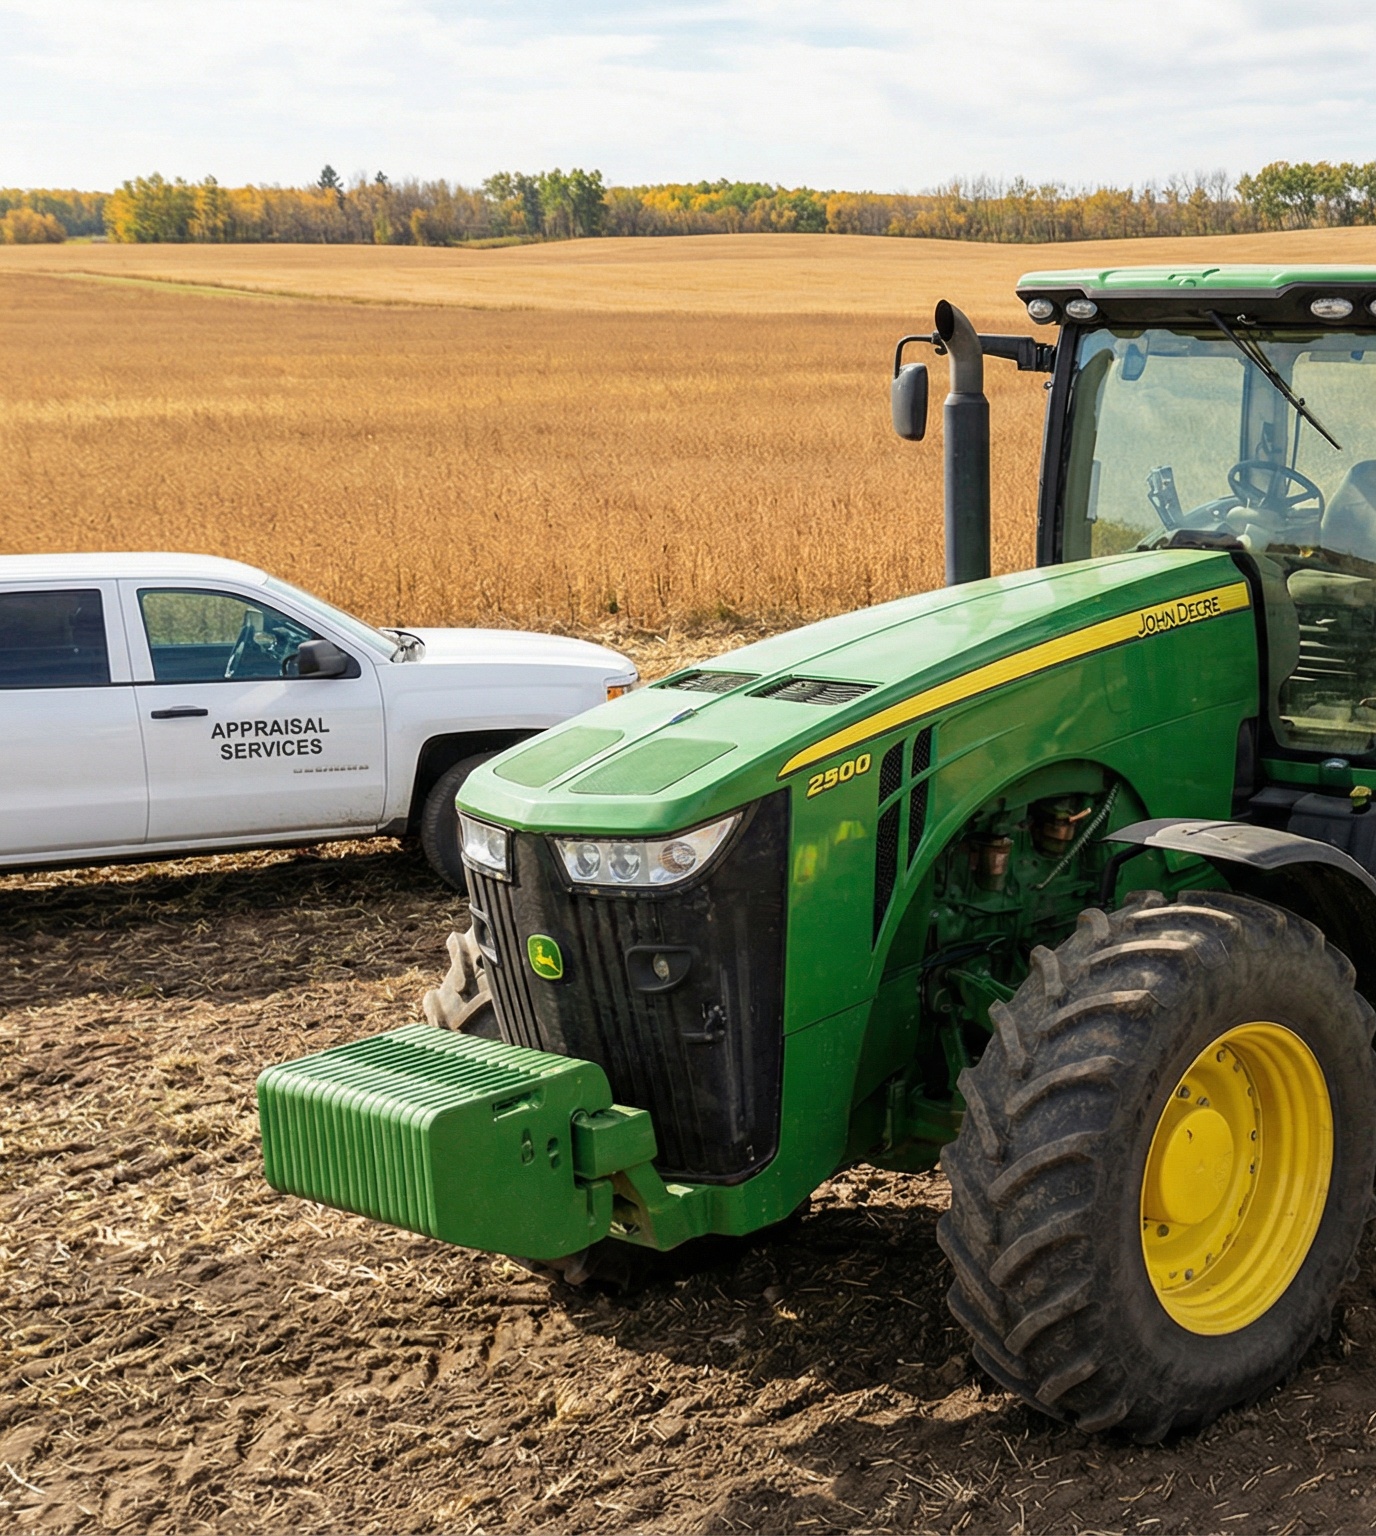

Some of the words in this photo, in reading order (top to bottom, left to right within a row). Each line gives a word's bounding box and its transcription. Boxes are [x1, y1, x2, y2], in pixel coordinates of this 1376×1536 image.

[1138, 607, 1176, 635] JOHN
[211, 717, 330, 740] APPRAISAL
[220, 738, 323, 760] SERVICES
[806, 752, 871, 800] 2500
